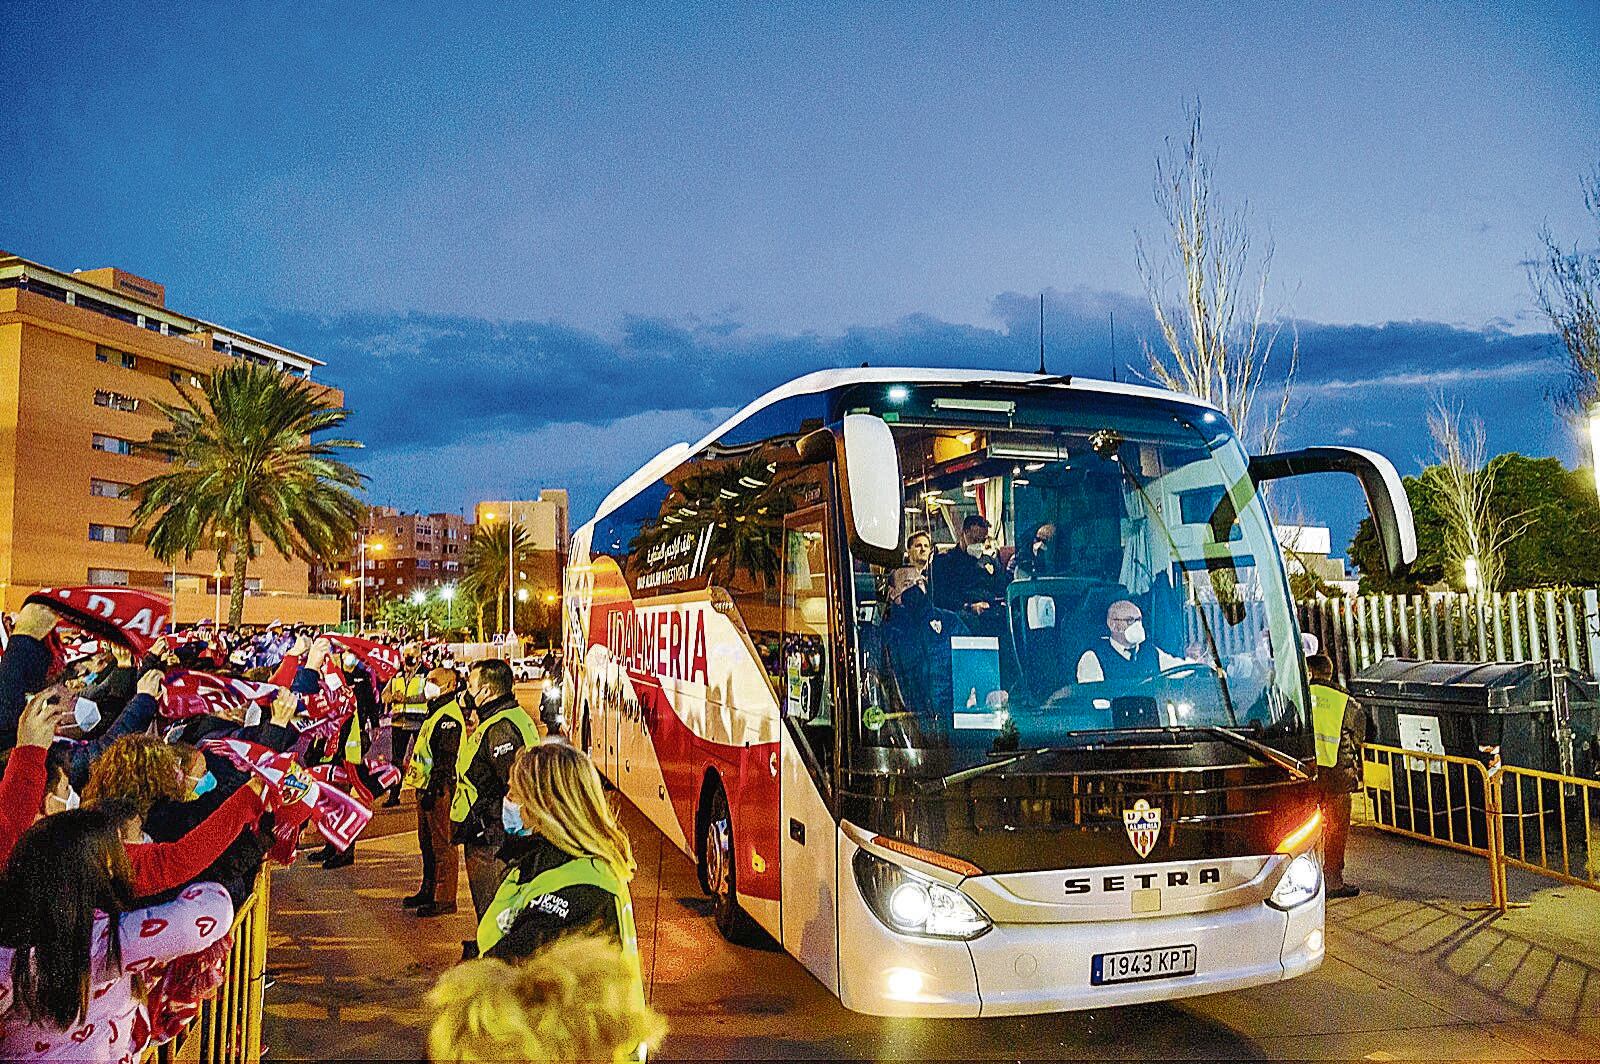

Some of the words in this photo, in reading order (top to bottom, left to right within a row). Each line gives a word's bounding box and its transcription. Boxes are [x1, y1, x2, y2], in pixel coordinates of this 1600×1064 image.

[1064, 868, 1221, 895] SETRA
[1109, 954, 1152, 977] 1943
[1158, 949, 1191, 971] KPT
